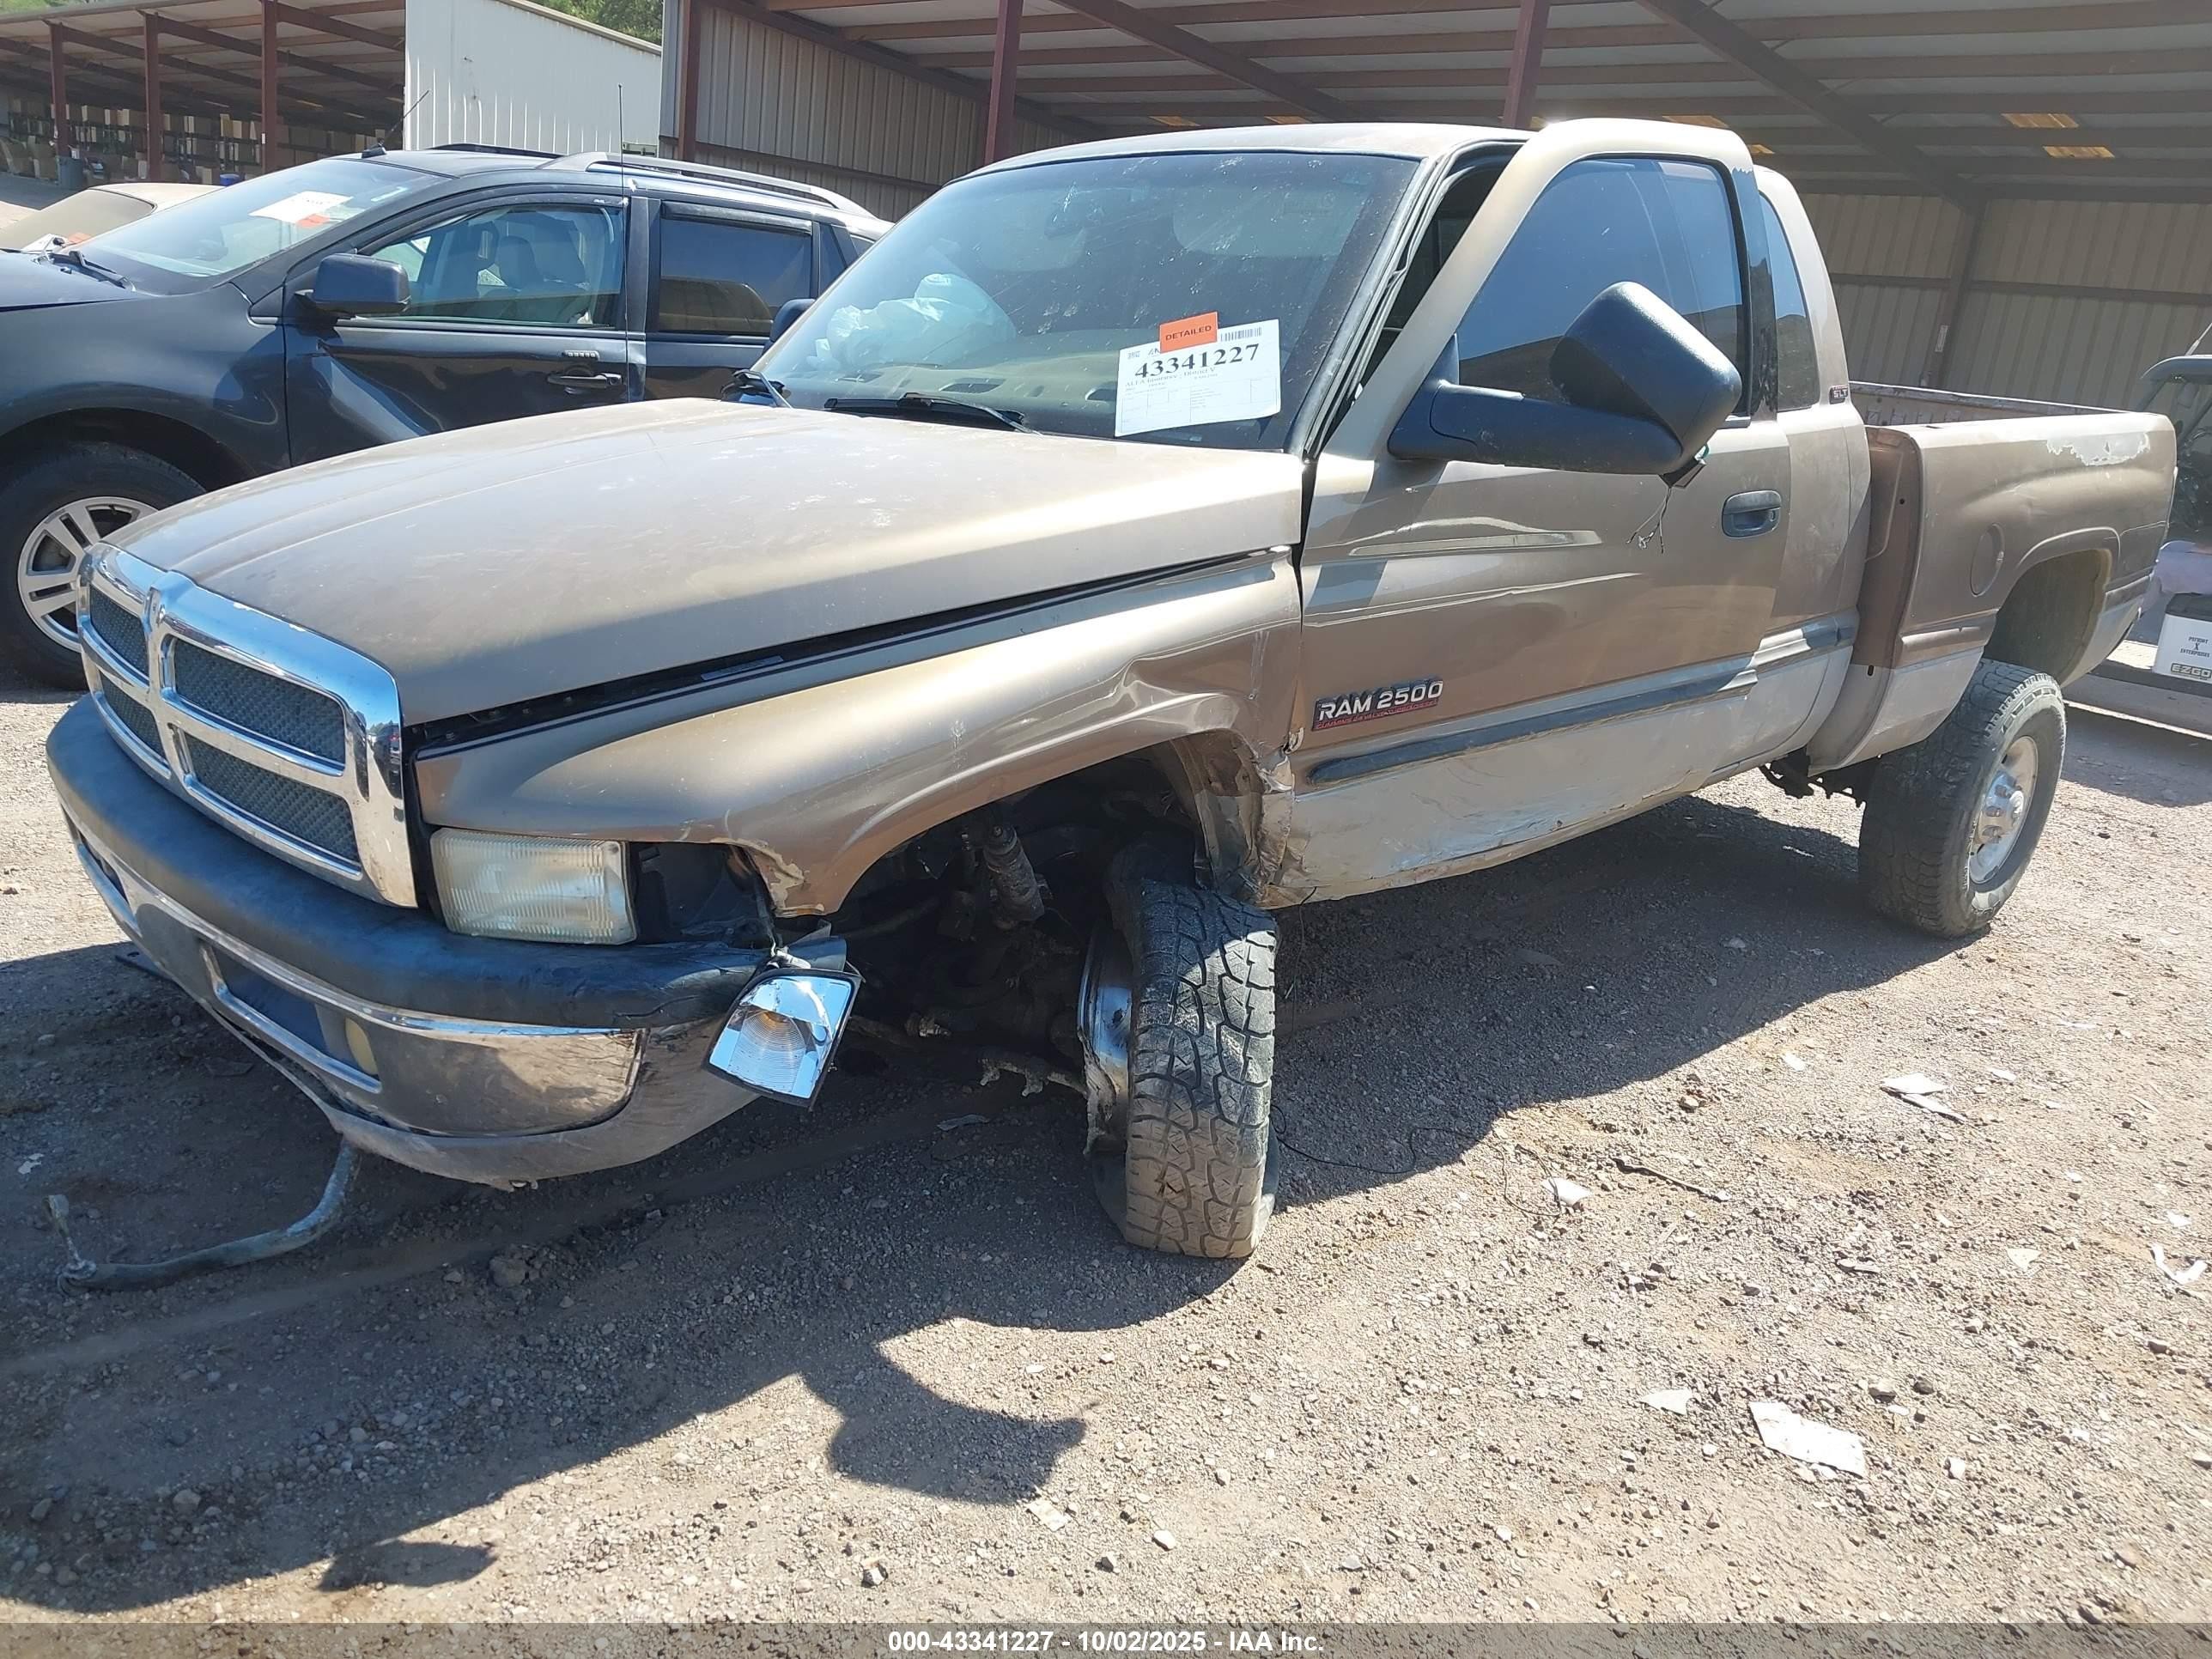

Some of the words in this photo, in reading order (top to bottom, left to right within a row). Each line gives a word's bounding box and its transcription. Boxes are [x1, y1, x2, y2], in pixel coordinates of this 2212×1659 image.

[1165, 325, 1212, 341] DETAILED
[1134, 343, 1260, 379] 43341227
[1833, 389, 1847, 398] SLT
[1319, 696, 1372, 721] RAM
[1377, 681, 1443, 708] 2500
